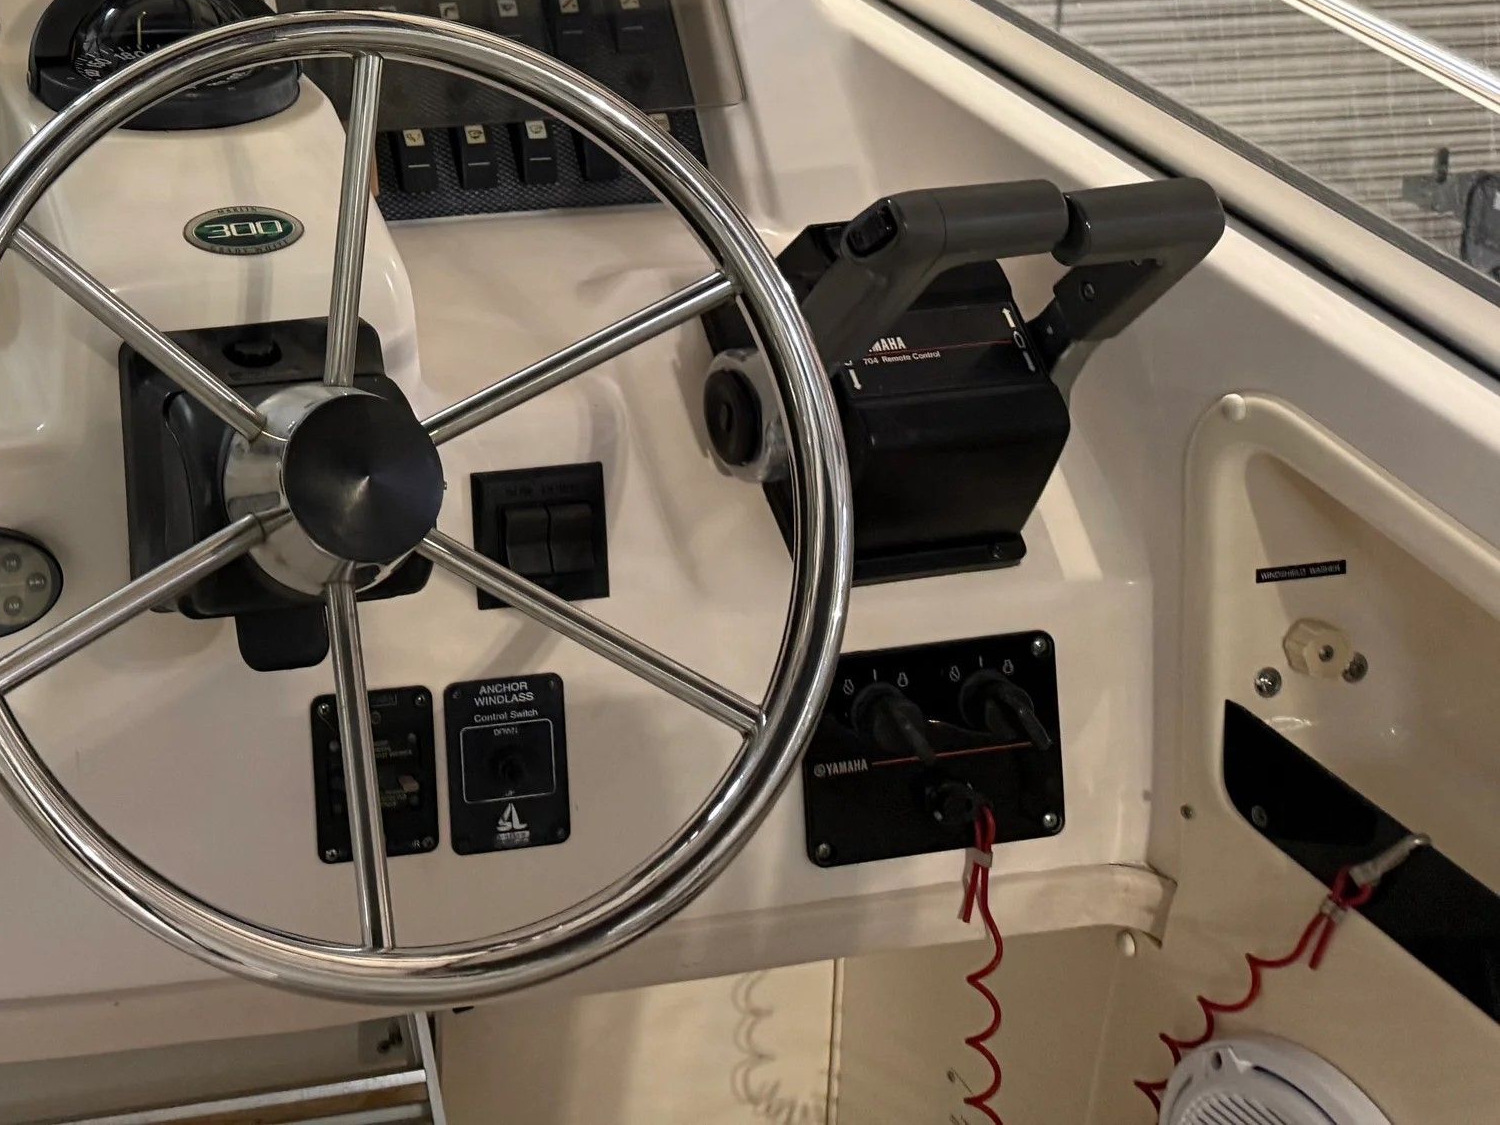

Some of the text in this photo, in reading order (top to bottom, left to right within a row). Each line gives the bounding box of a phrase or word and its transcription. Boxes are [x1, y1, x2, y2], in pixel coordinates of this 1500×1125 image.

[204, 220, 283, 239] 300
[869, 336, 907, 353] MAHA
[863, 351, 940, 366] 704 Remote Control
[479, 681, 528, 695] ANCHOR
[474, 691, 534, 706] WINDLASS
[474, 708, 538, 723] Control Switch
[825, 758, 868, 776] YAMAHA
